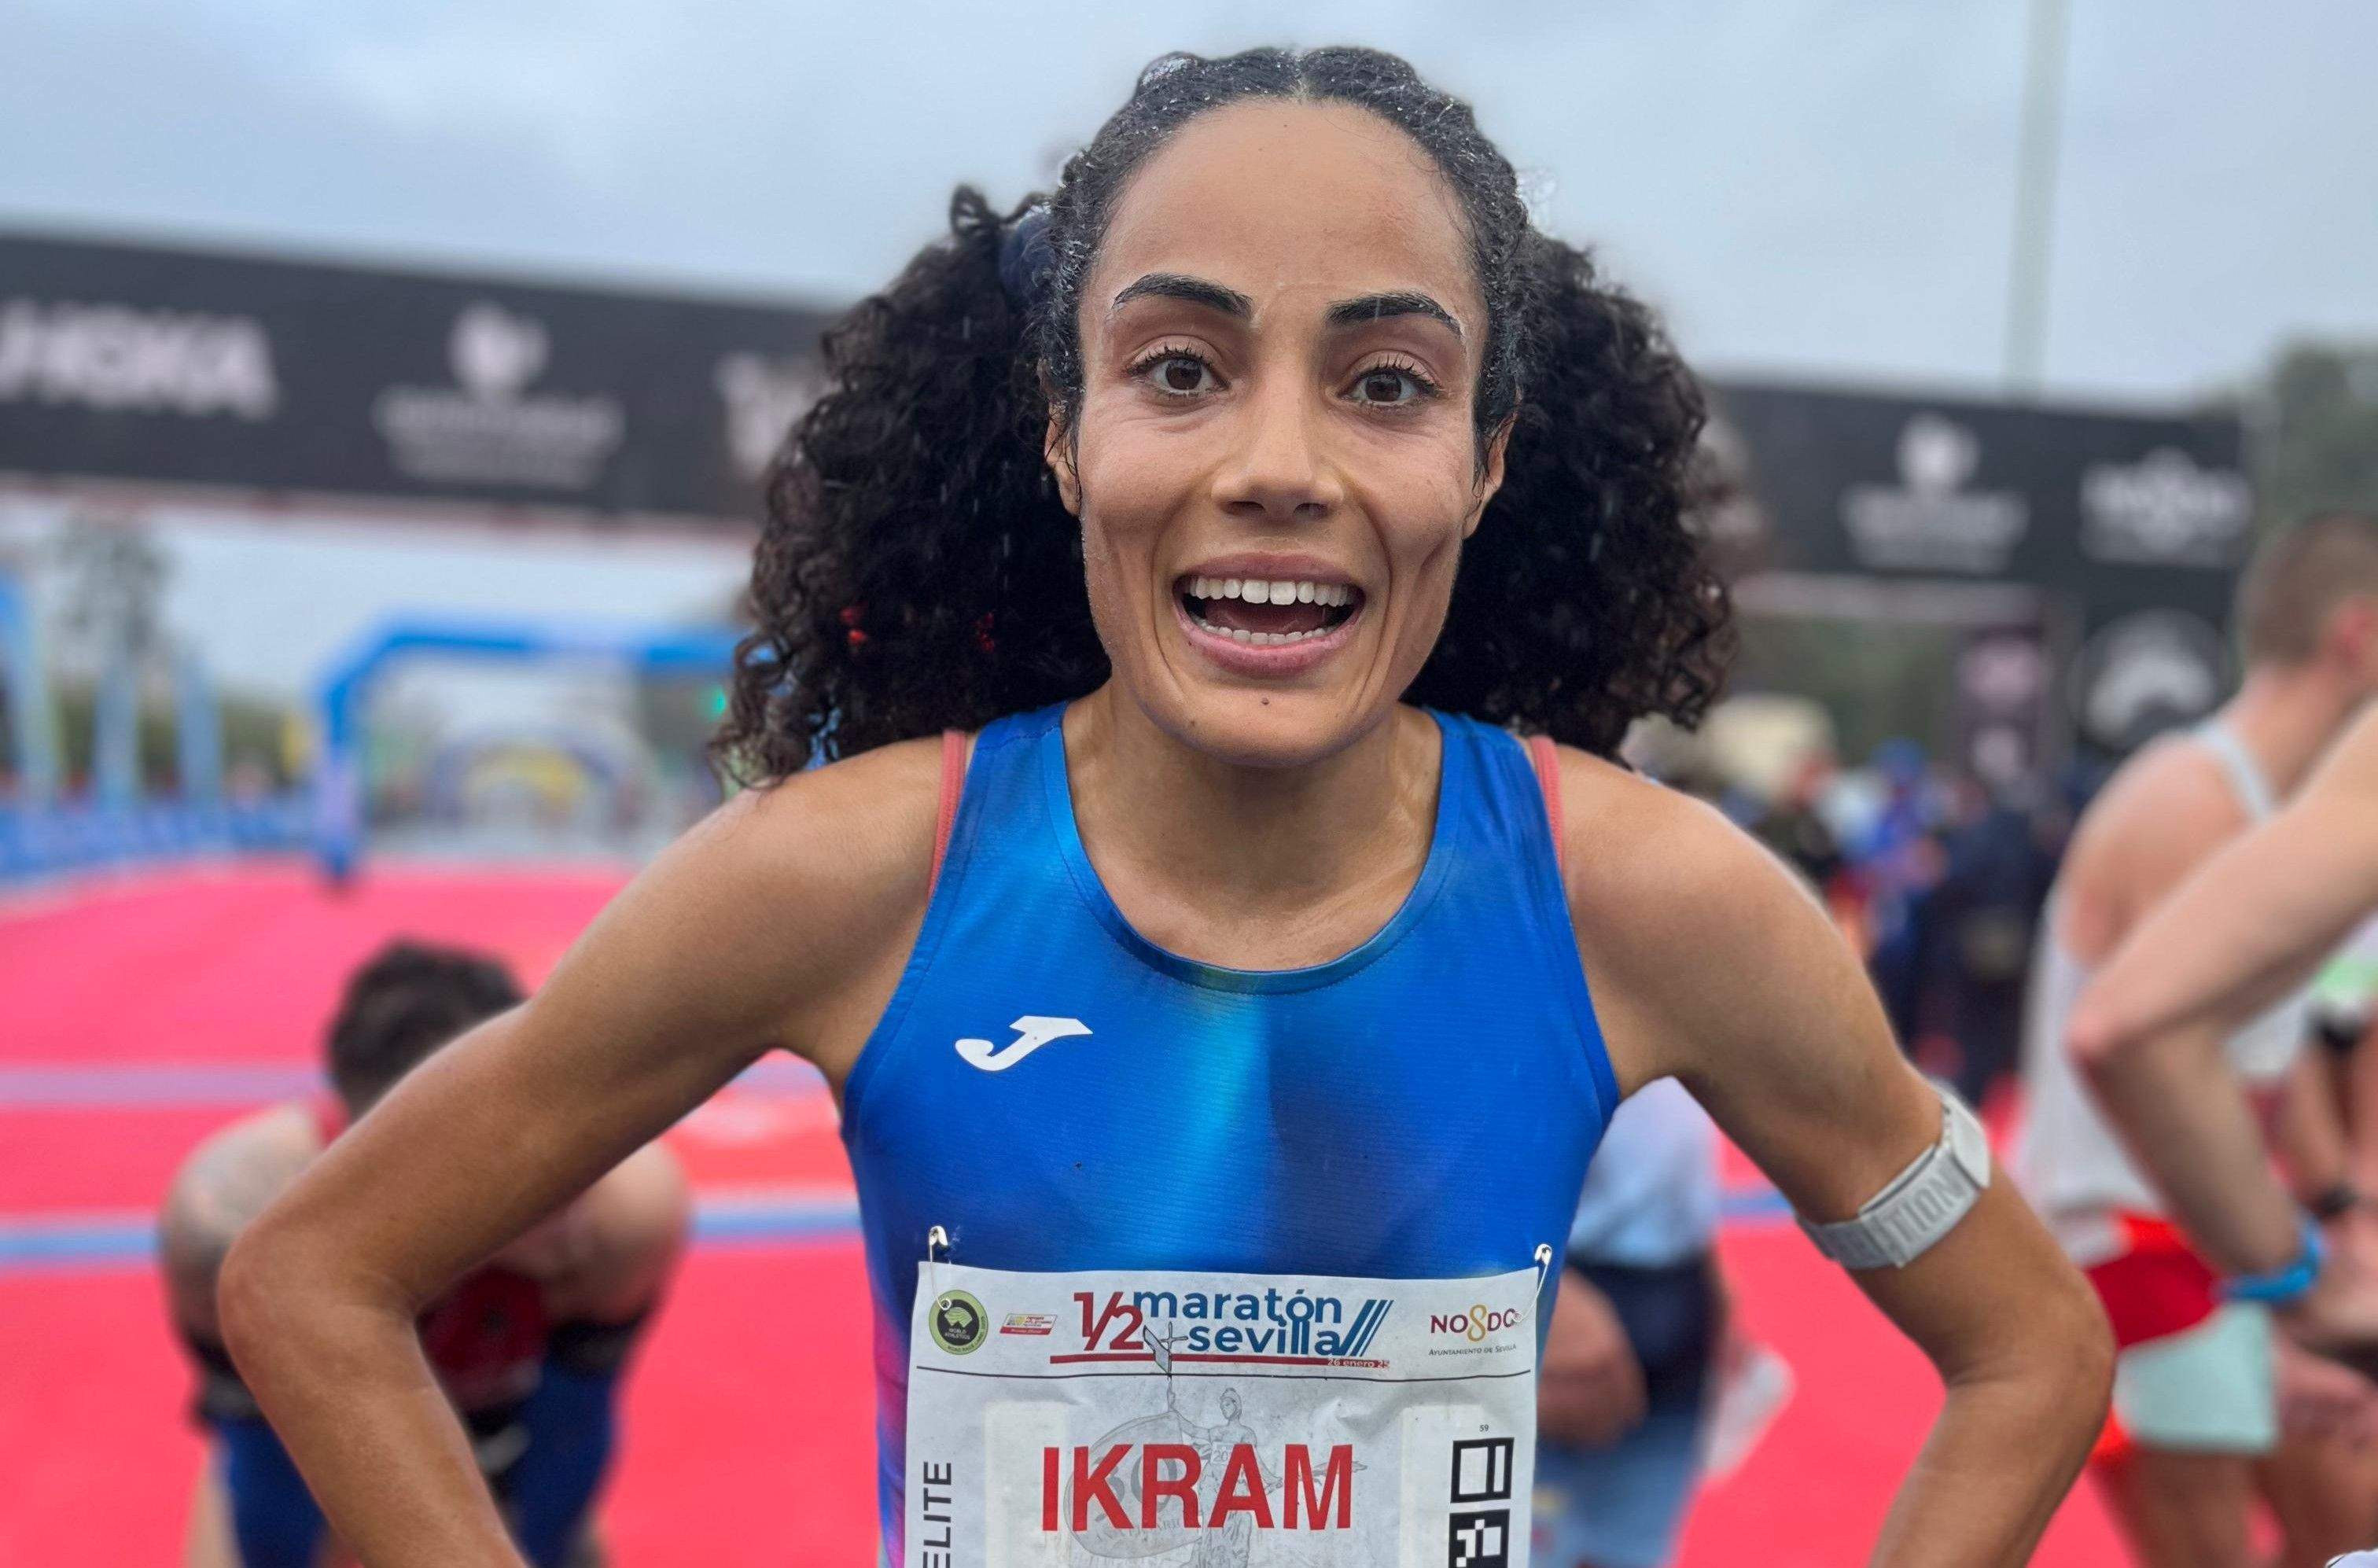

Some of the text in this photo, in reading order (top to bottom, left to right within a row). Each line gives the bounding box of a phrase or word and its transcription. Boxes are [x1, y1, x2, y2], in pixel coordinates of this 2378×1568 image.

[1133, 1287, 1342, 1323] maratón
[1187, 1316, 1344, 1356] sevilla
[923, 1461, 952, 1568] ELITE
[1043, 1443, 1353, 1532] IKRAM
